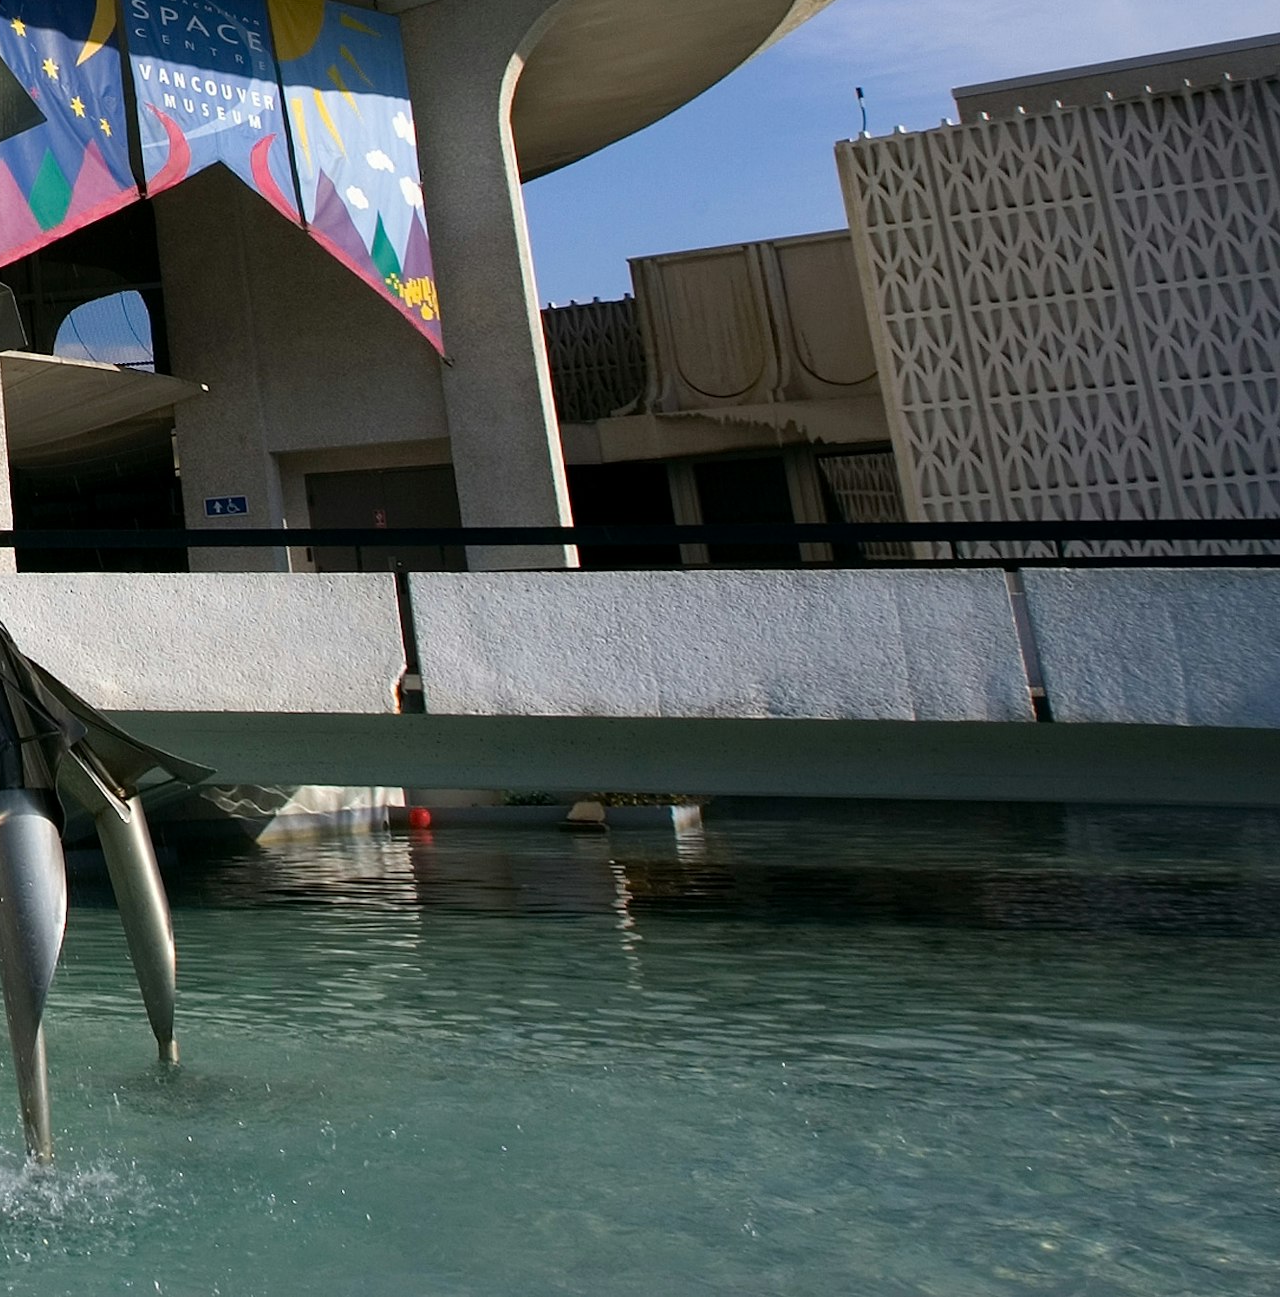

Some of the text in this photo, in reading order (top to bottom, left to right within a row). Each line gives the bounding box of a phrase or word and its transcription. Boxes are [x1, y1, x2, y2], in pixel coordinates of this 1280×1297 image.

[131, 0, 262, 52] SPACE
[134, 28, 266, 70] CENTRE
[139, 64, 275, 111] VANCOUVER
[163, 93, 261, 129] MUSEUM
